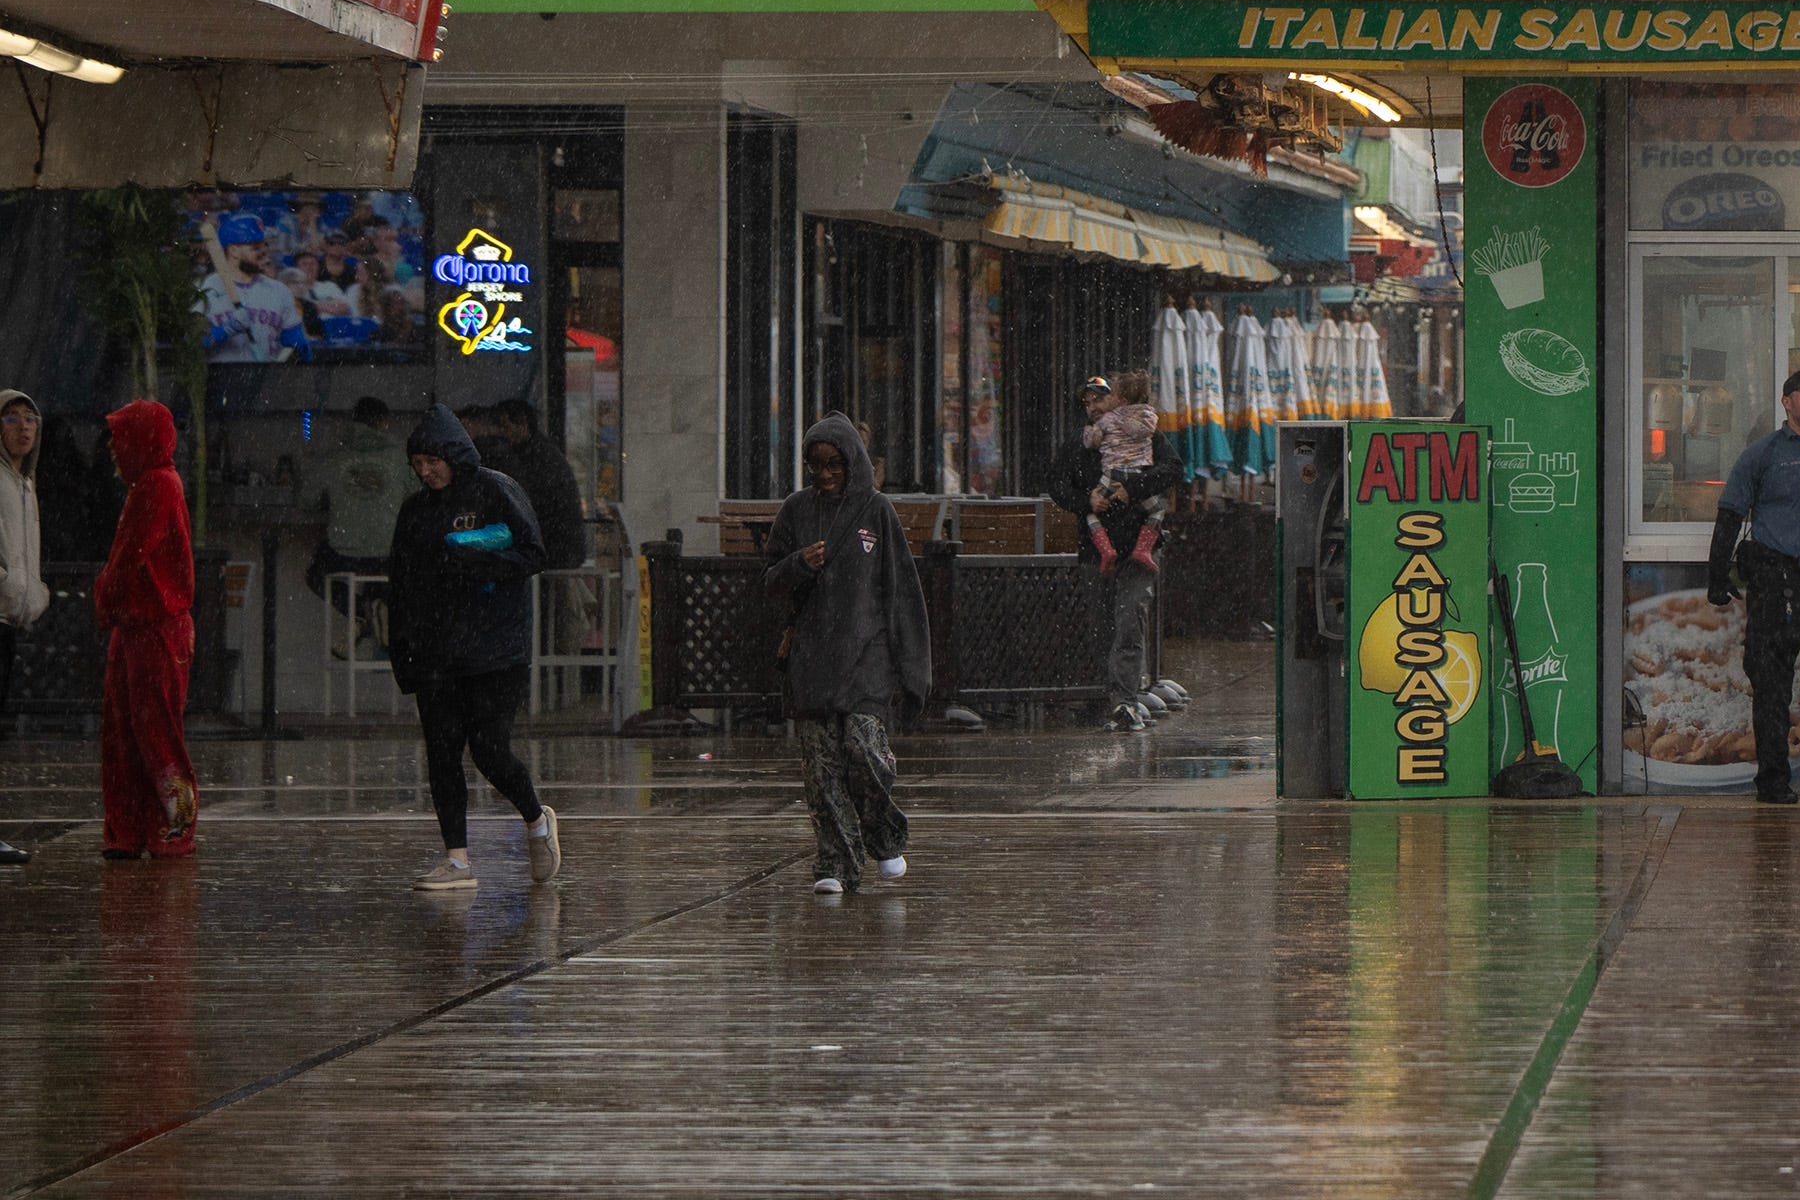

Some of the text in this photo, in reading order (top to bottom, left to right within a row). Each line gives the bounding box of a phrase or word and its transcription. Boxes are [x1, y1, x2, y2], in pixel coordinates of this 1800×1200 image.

[1237, 8, 1505, 51] ITALIAN
[1499, 113, 1569, 152] Coca-Cola
[1640, 144, 1713, 168] Fried
[1668, 189, 1778, 224] OREO
[433, 253, 531, 286] Corona
[1356, 431, 1479, 504] ATM
[1394, 511, 1449, 785] SAUSAGE
